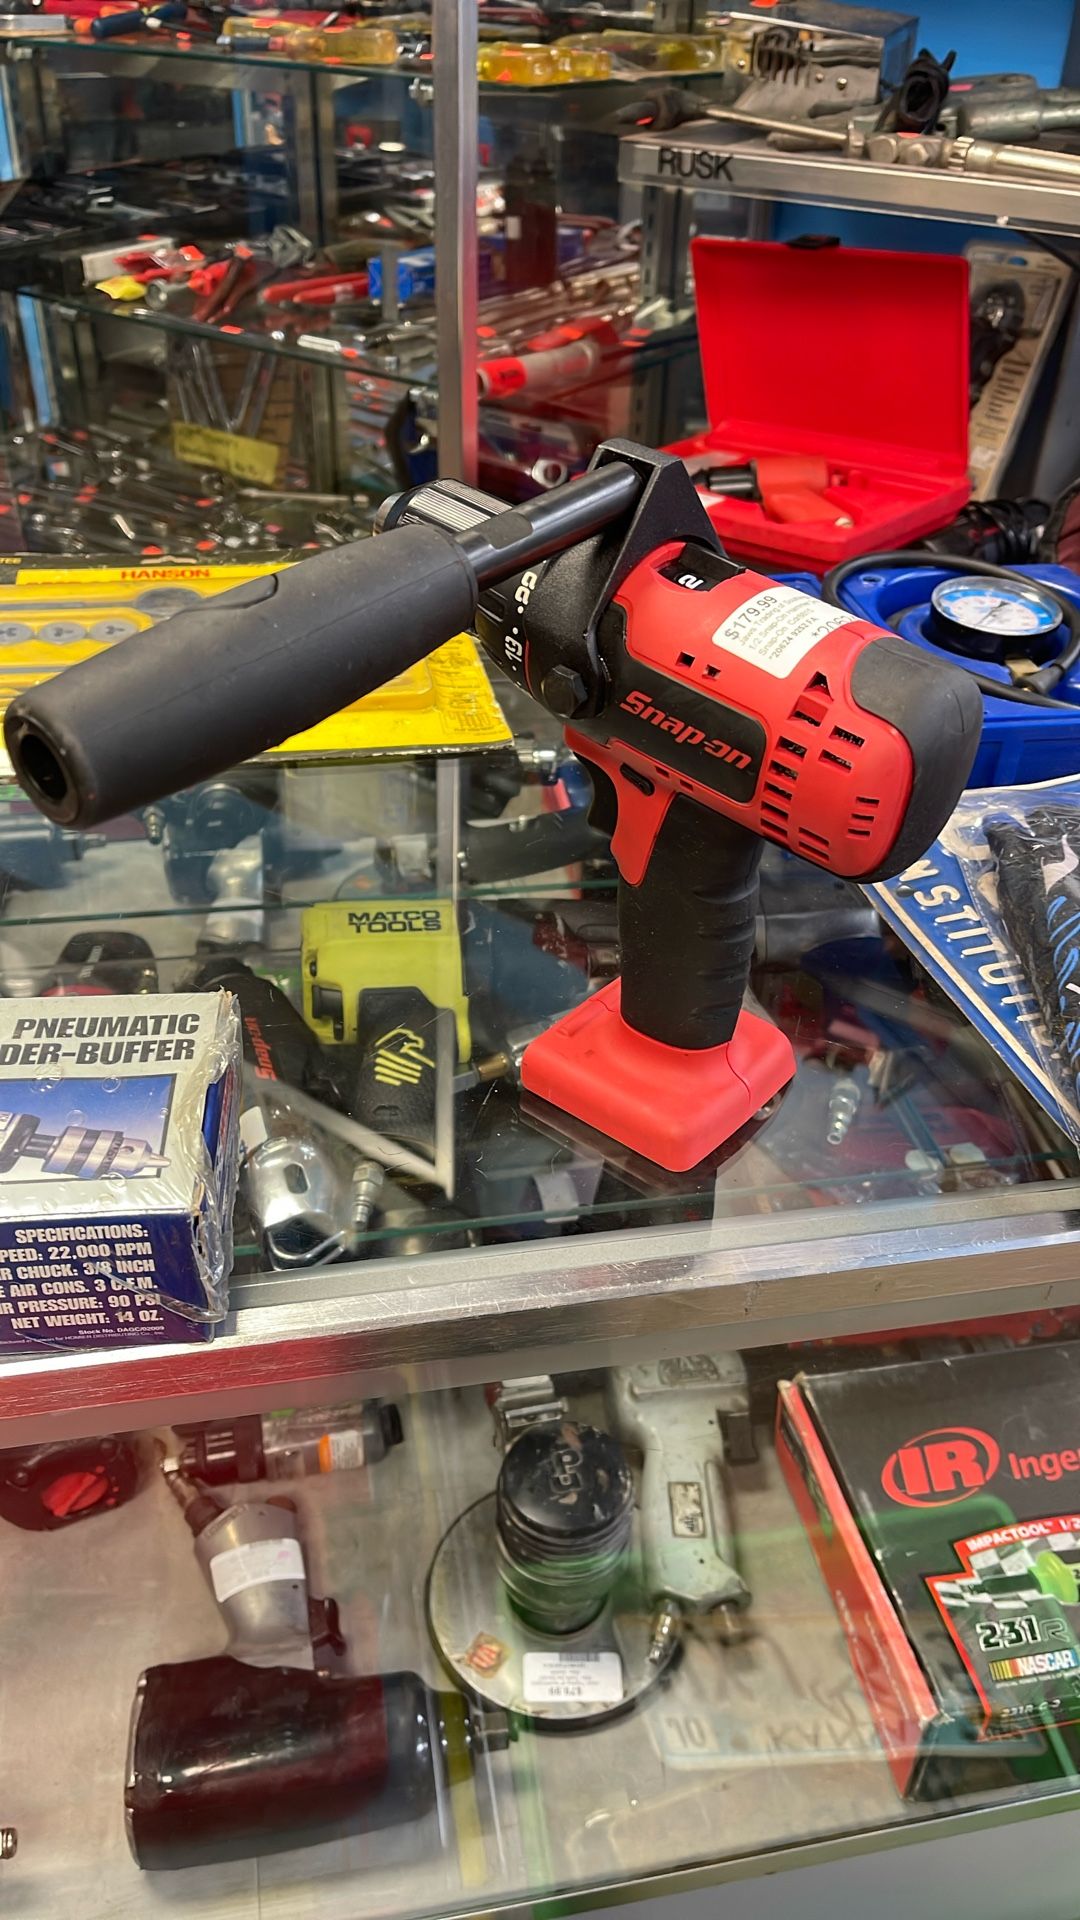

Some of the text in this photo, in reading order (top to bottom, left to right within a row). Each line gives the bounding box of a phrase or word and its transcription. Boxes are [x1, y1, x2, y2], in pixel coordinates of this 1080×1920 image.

[658, 146, 733, 182] RUSK
[121, 569, 210, 579] HANSON
[724, 595, 777, 640] $179.99
[619, 690, 752, 769] Snap-on
[348, 910, 440, 924] MATCO
[352, 921, 442, 933] TOOLS
[12, 1014, 200, 1039] PNEUMATIC
[0, 1039, 196, 1066] DER-BUFFER
[15, 1224, 148, 1243] SPECIFICATIONS:
[48, 1244, 111, 1259] 22,000
[115, 1242, 152, 1256] RPM
[16, 1264, 78, 1279] CHUCK:
[83, 1262, 112, 1275] 3/8
[116, 1259, 155, 1273] INCH
[10, 1283, 38, 1298] AIR
[41, 1280, 90, 1295] CONS.
[94, 1279, 107, 1292] 3
[18, 1296, 103, 1313] PRESSURE:
[108, 1294, 131, 1308] 90
[134, 1293, 161, 1306] PSI
[11, 1309, 164, 1329] NET WEIGHT: 14 OZ.
[897, 1439, 986, 1495] IR
[1008, 1448, 1080, 1481] Inge
[1017, 1649, 1075, 1676] NASCAR
